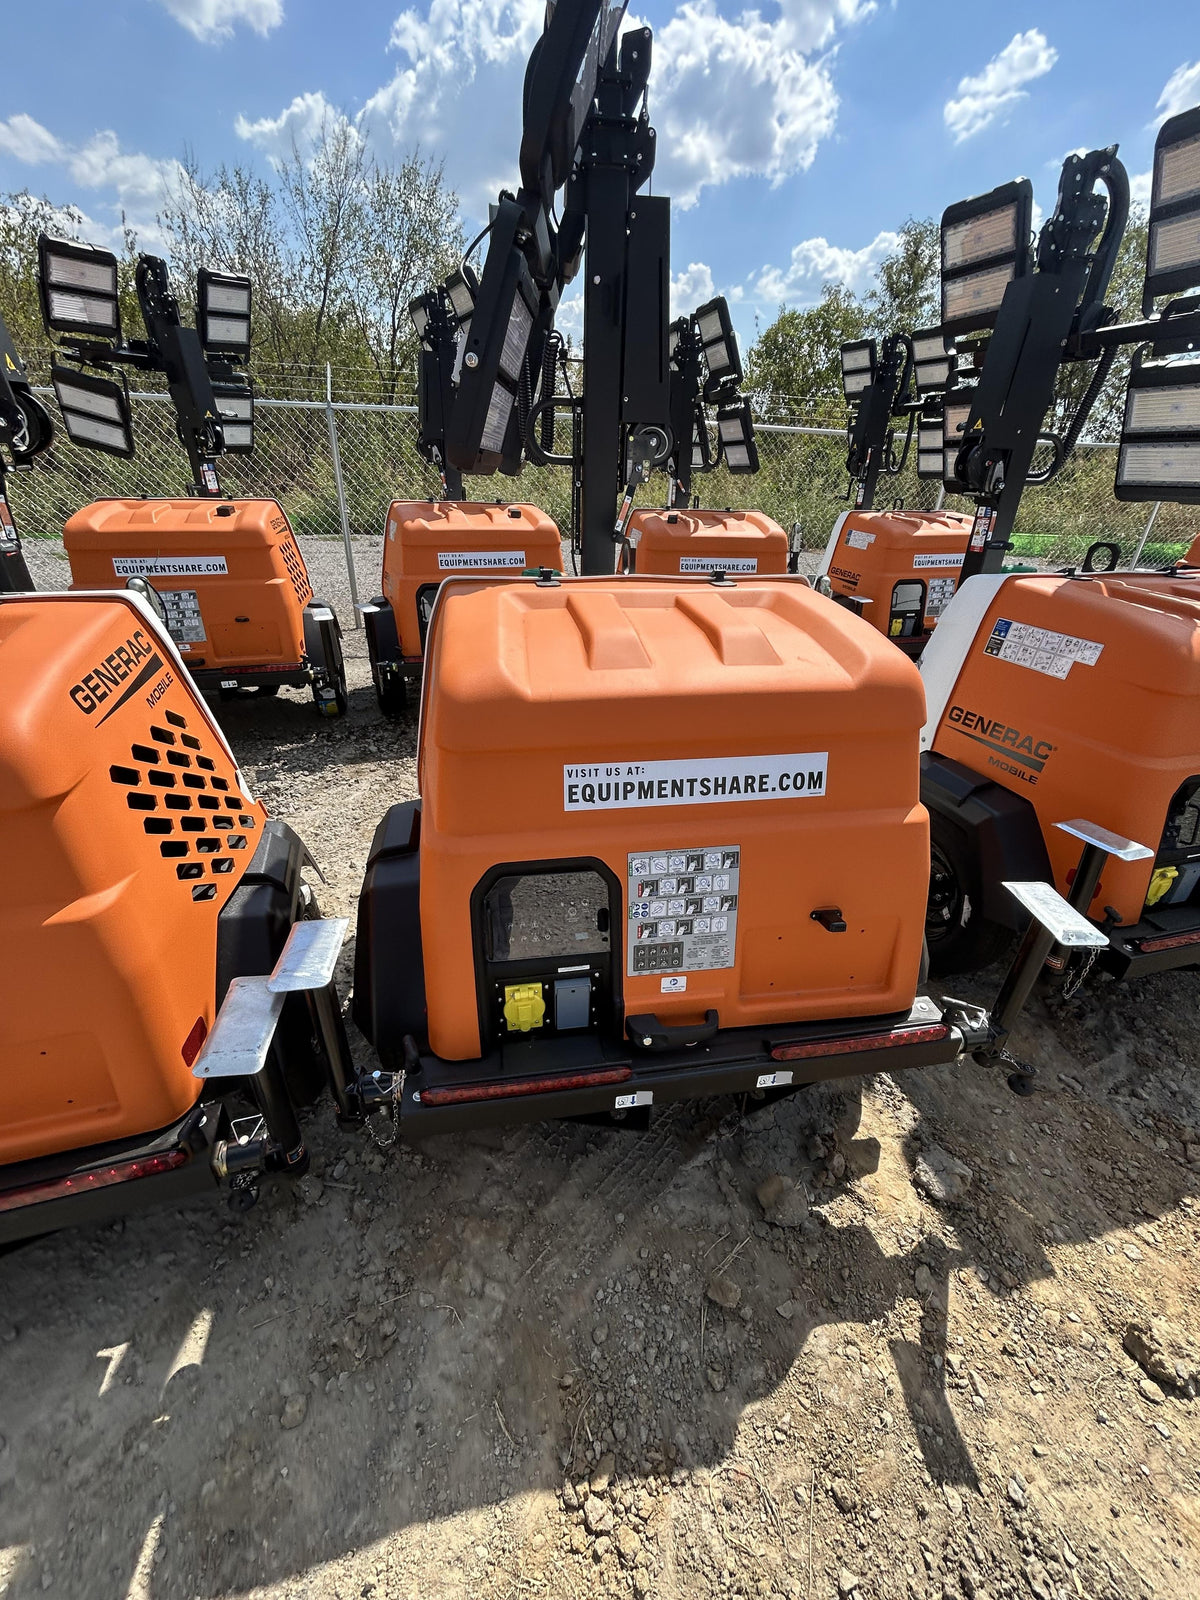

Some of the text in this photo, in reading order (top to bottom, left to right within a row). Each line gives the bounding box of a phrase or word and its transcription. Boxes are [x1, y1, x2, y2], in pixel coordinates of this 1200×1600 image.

[115, 563, 226, 574] EQUIPMENTSHARE.COM
[439, 557, 525, 567] EQUIPMENTSHARE.COM
[680, 563, 756, 571] EQUIPMENTSHARE.COM
[914, 558, 963, 567] EQUIPMENTSHARE
[830, 566, 861, 581] GENERAC
[69, 630, 153, 715] GENERAC
[145, 671, 174, 709] MOBILE
[948, 705, 1053, 761] GENERAC
[567, 766, 645, 778] VISIT US AT:
[987, 755, 1039, 785] MOBILE
[567, 770, 823, 804] EQUIPMENTSHARE.COM
